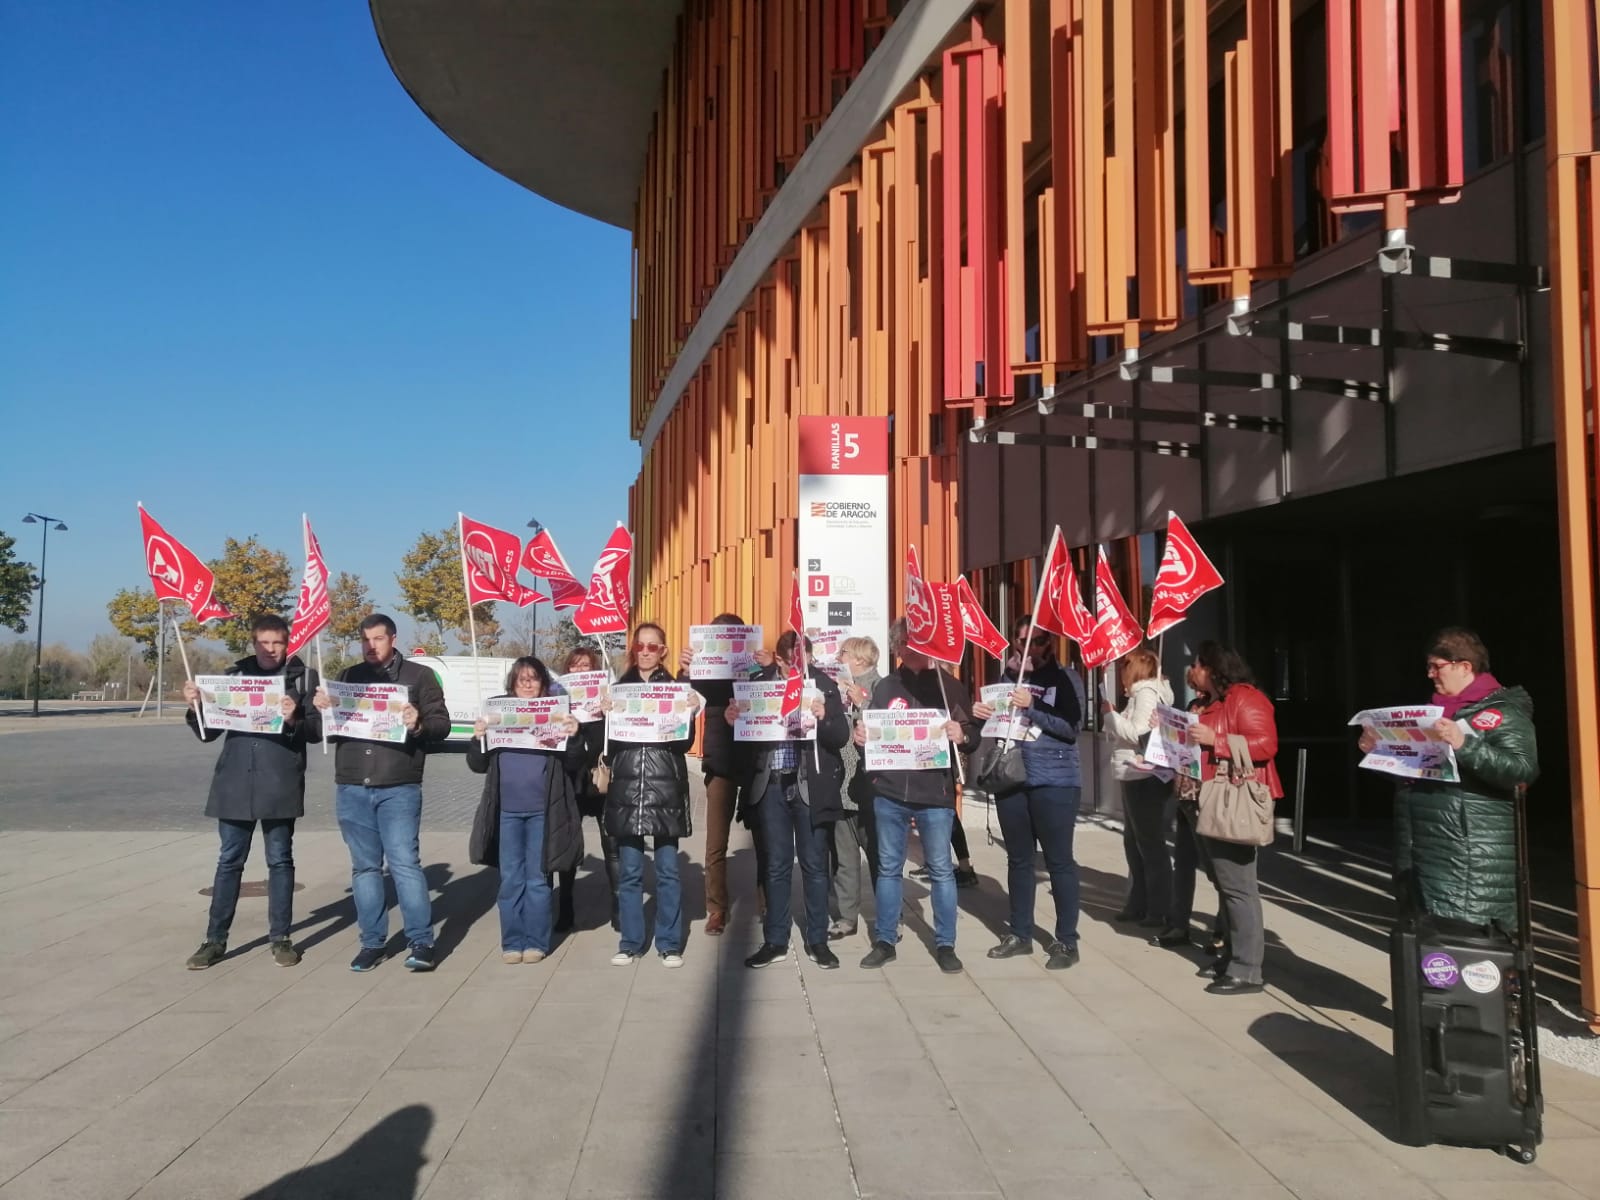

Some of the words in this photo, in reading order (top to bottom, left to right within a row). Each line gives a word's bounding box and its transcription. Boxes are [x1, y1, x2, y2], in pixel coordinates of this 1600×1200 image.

[831, 422, 841, 470] RANILLAS
[844, 433, 860, 459] 5
[826, 501, 871, 510] GOBIERNO
[826, 510, 838, 518] DE
[814, 579, 824, 592] D
